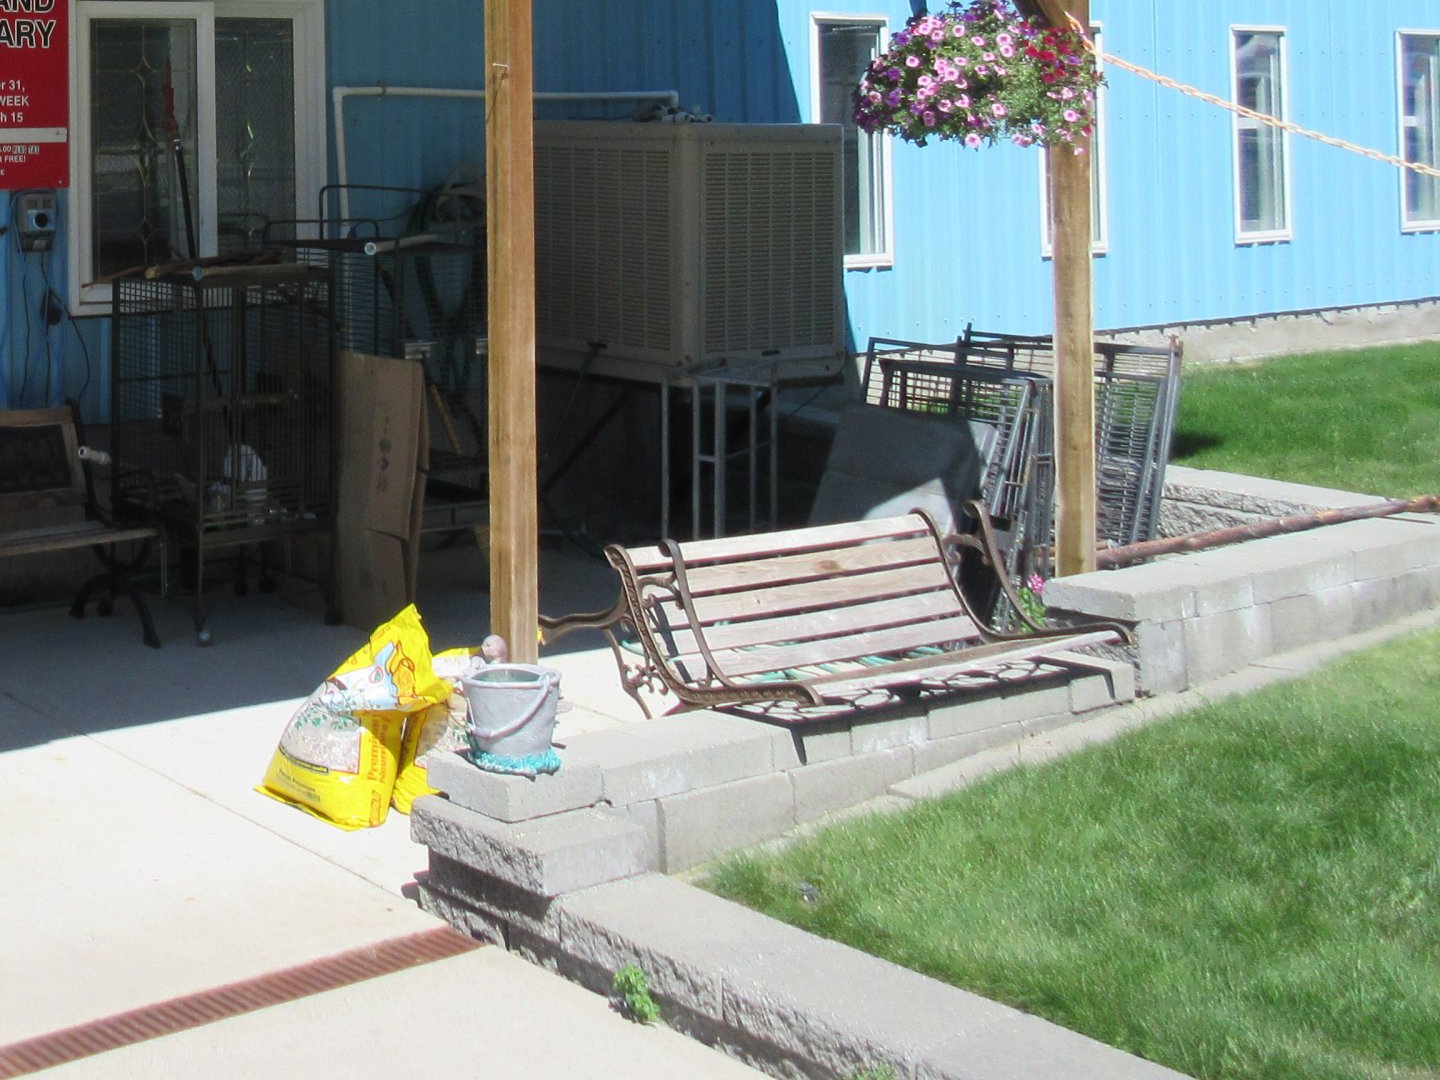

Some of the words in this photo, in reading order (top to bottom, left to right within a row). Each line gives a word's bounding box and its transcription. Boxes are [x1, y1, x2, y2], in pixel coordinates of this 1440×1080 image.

[8, 79, 26, 92] 31,
[10, 112, 24, 123] 15
[4, 154, 26, 163] FREE!
